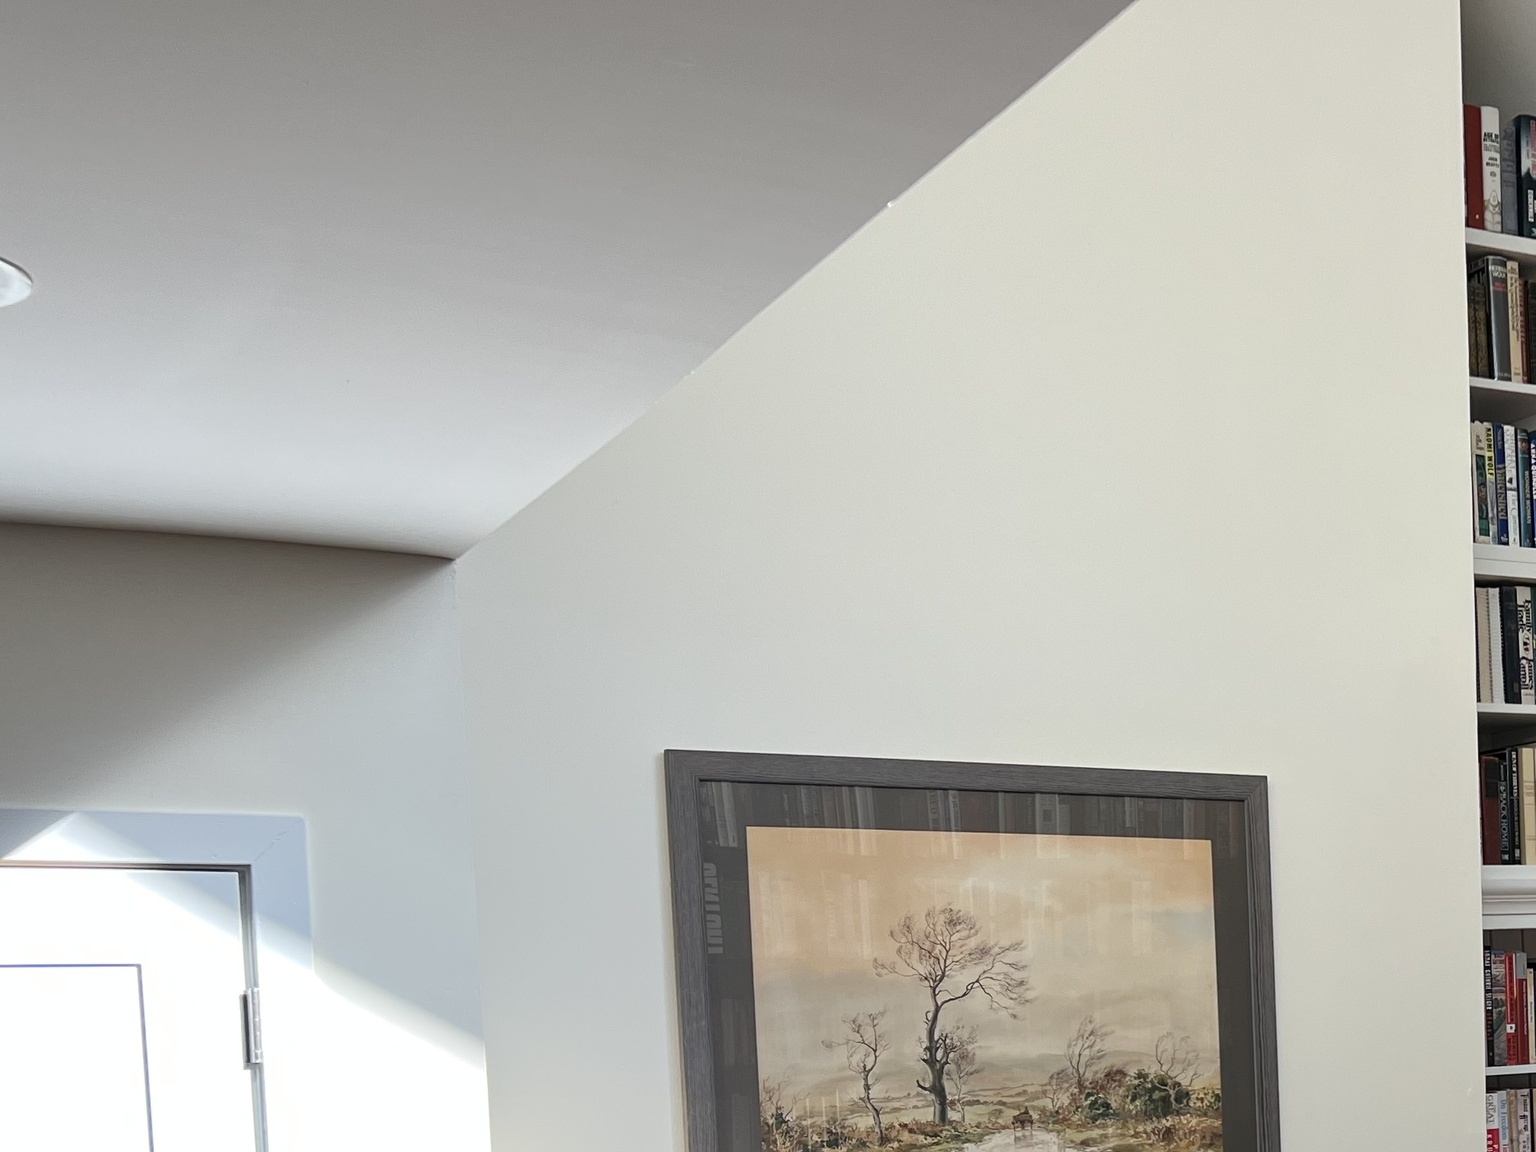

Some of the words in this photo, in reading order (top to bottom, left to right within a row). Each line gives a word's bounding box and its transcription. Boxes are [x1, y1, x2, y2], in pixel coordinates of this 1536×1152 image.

[1501, 819, 1509, 846] HOME
[1488, 1094, 1496, 1124] GREAT
[1501, 1099, 1508, 1109] On
